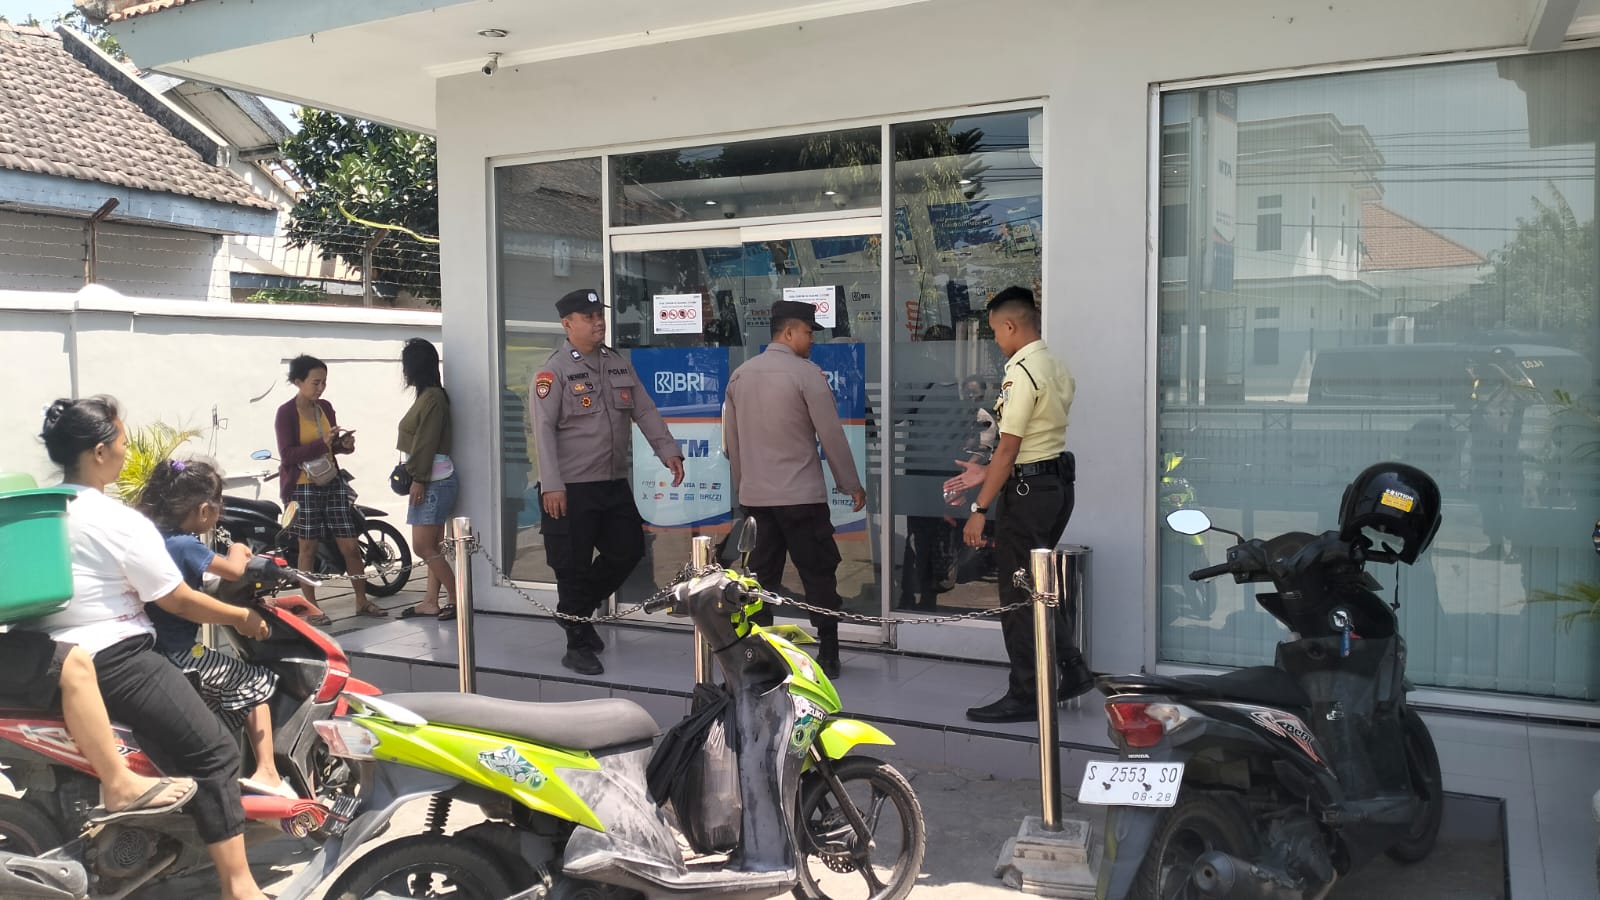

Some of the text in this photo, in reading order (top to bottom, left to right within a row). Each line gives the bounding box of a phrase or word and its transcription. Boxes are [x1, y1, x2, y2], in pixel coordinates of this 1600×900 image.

[674, 372, 705, 392] BRI
[824, 370, 838, 391] RI
[675, 439, 709, 457] TM
[1088, 765, 1098, 780] S
[1109, 766, 1147, 783] 2553
